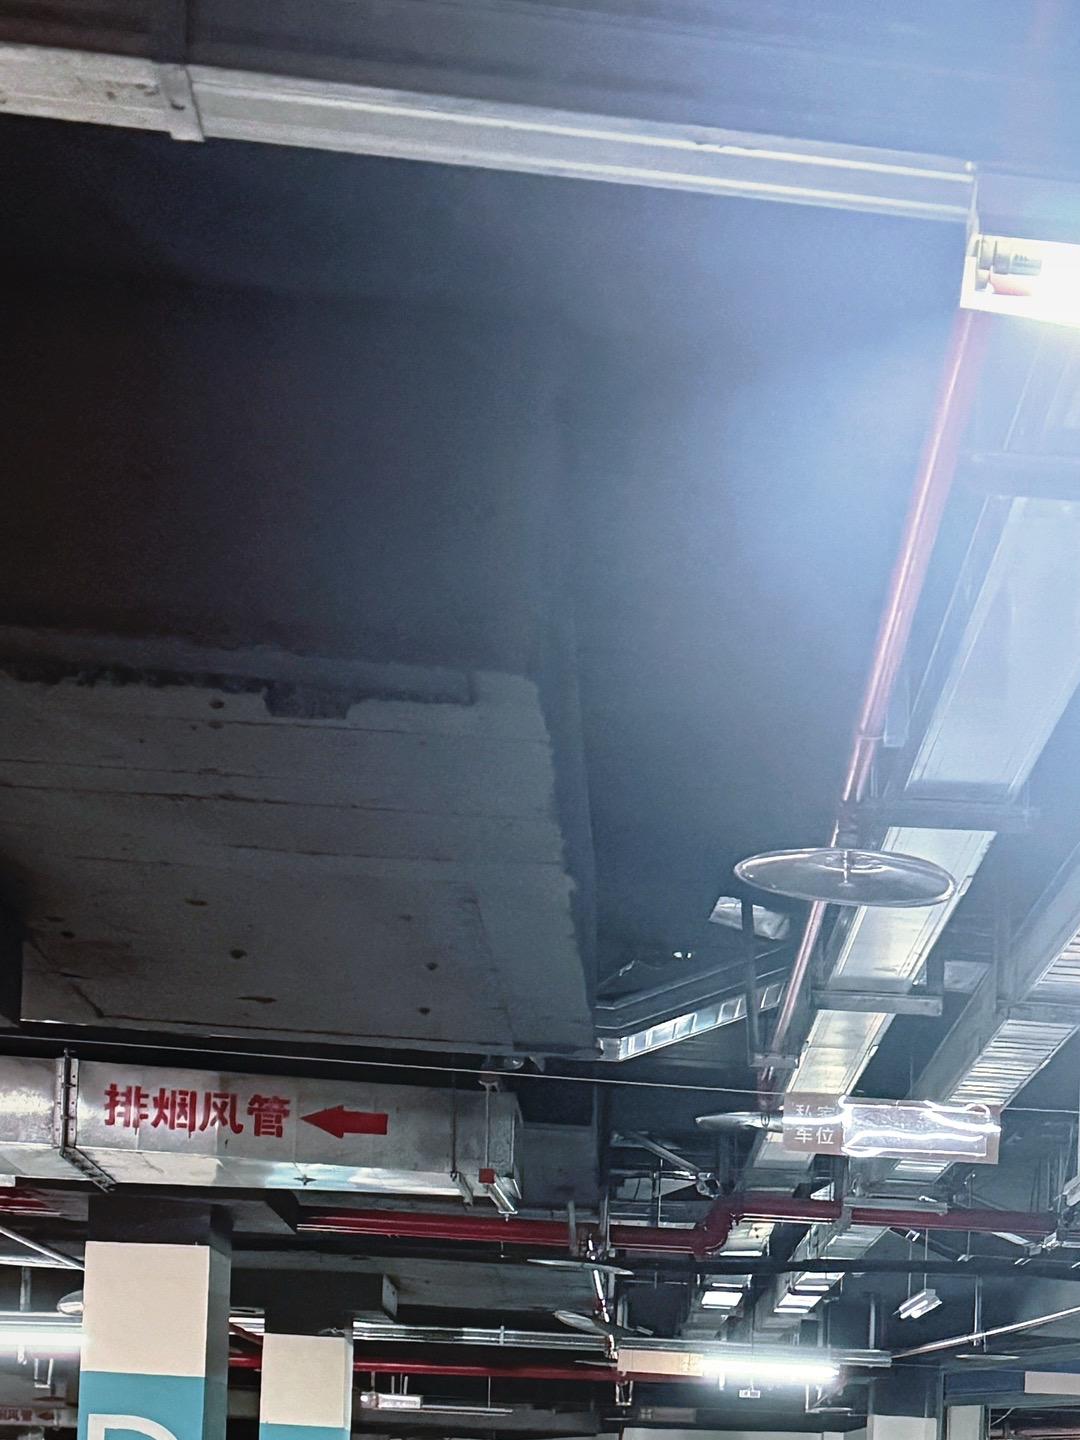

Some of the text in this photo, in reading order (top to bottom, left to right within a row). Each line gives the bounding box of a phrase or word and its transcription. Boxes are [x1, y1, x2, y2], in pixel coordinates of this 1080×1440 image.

[104, 1083, 291, 1138] 排烟风管
[794, 1126, 835, 1145] 车位
